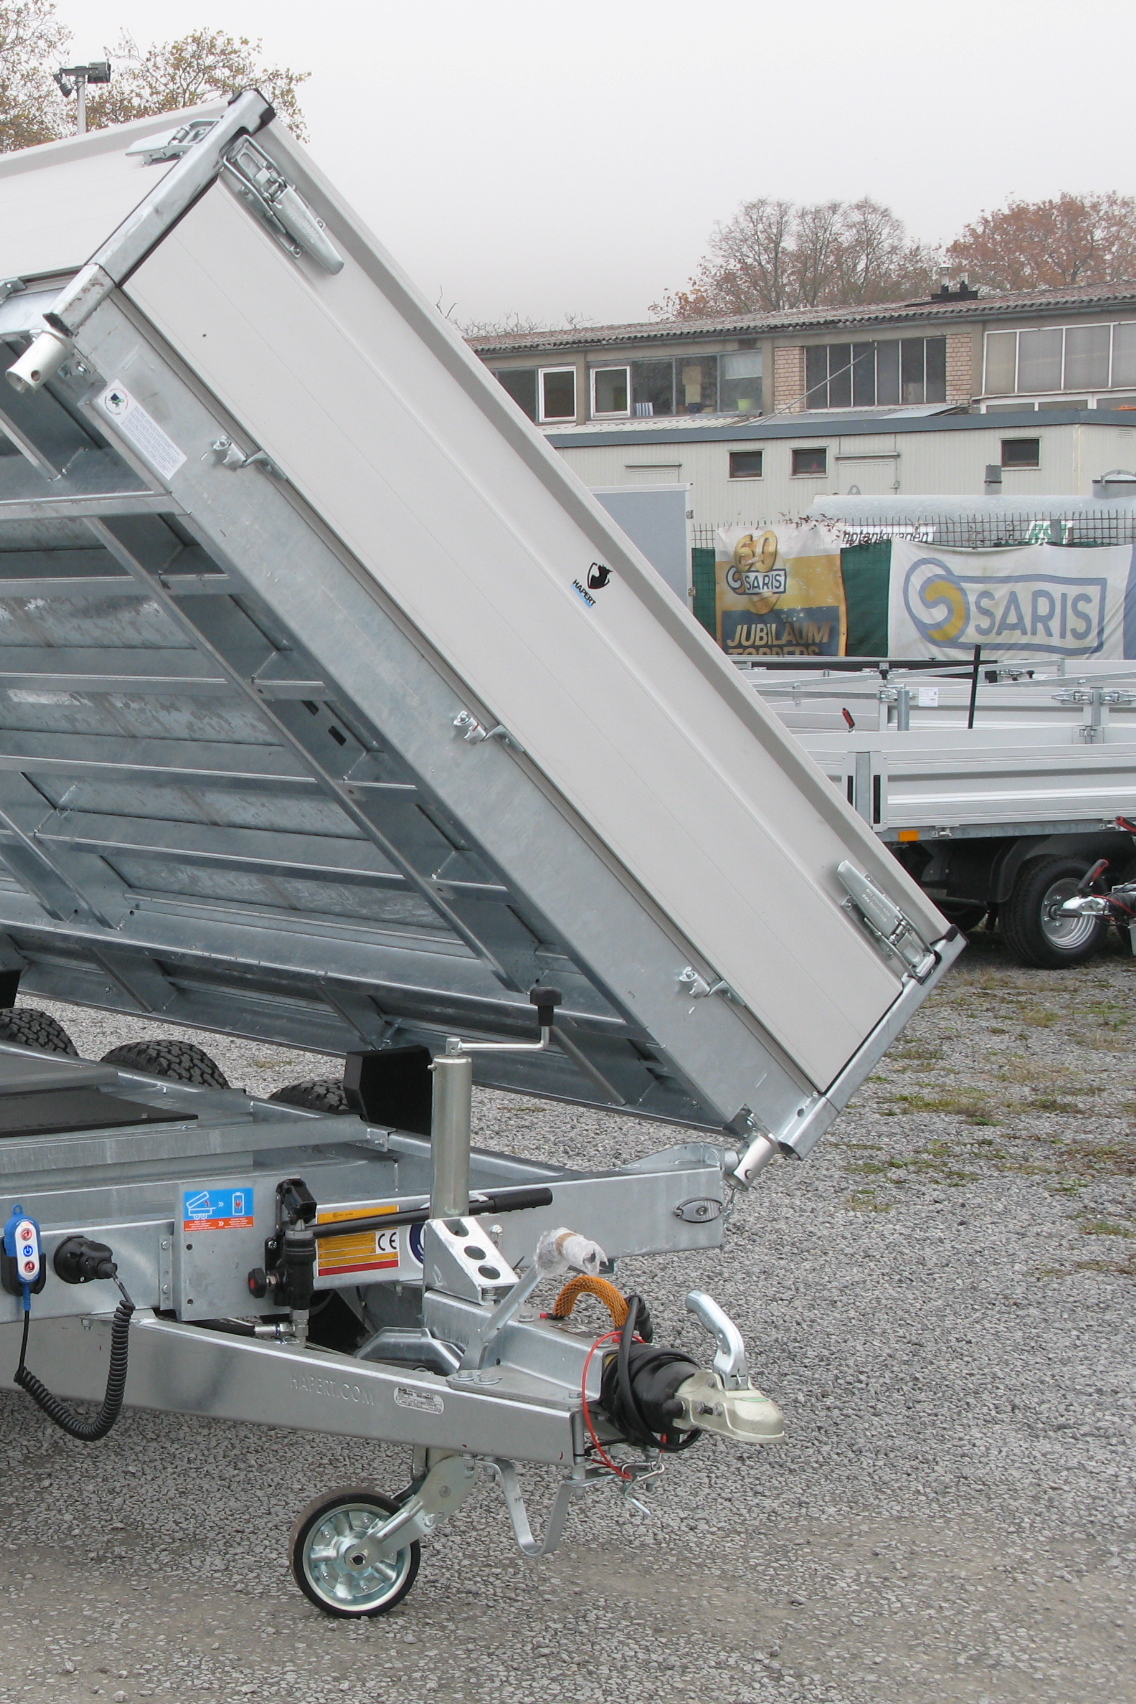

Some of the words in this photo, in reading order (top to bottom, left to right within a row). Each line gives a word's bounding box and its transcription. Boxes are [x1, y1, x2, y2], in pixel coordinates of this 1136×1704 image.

[572, 579, 596, 606] HAPERT
[744, 573, 782, 590] SARIS
[974, 590, 1093, 641] SARIS
